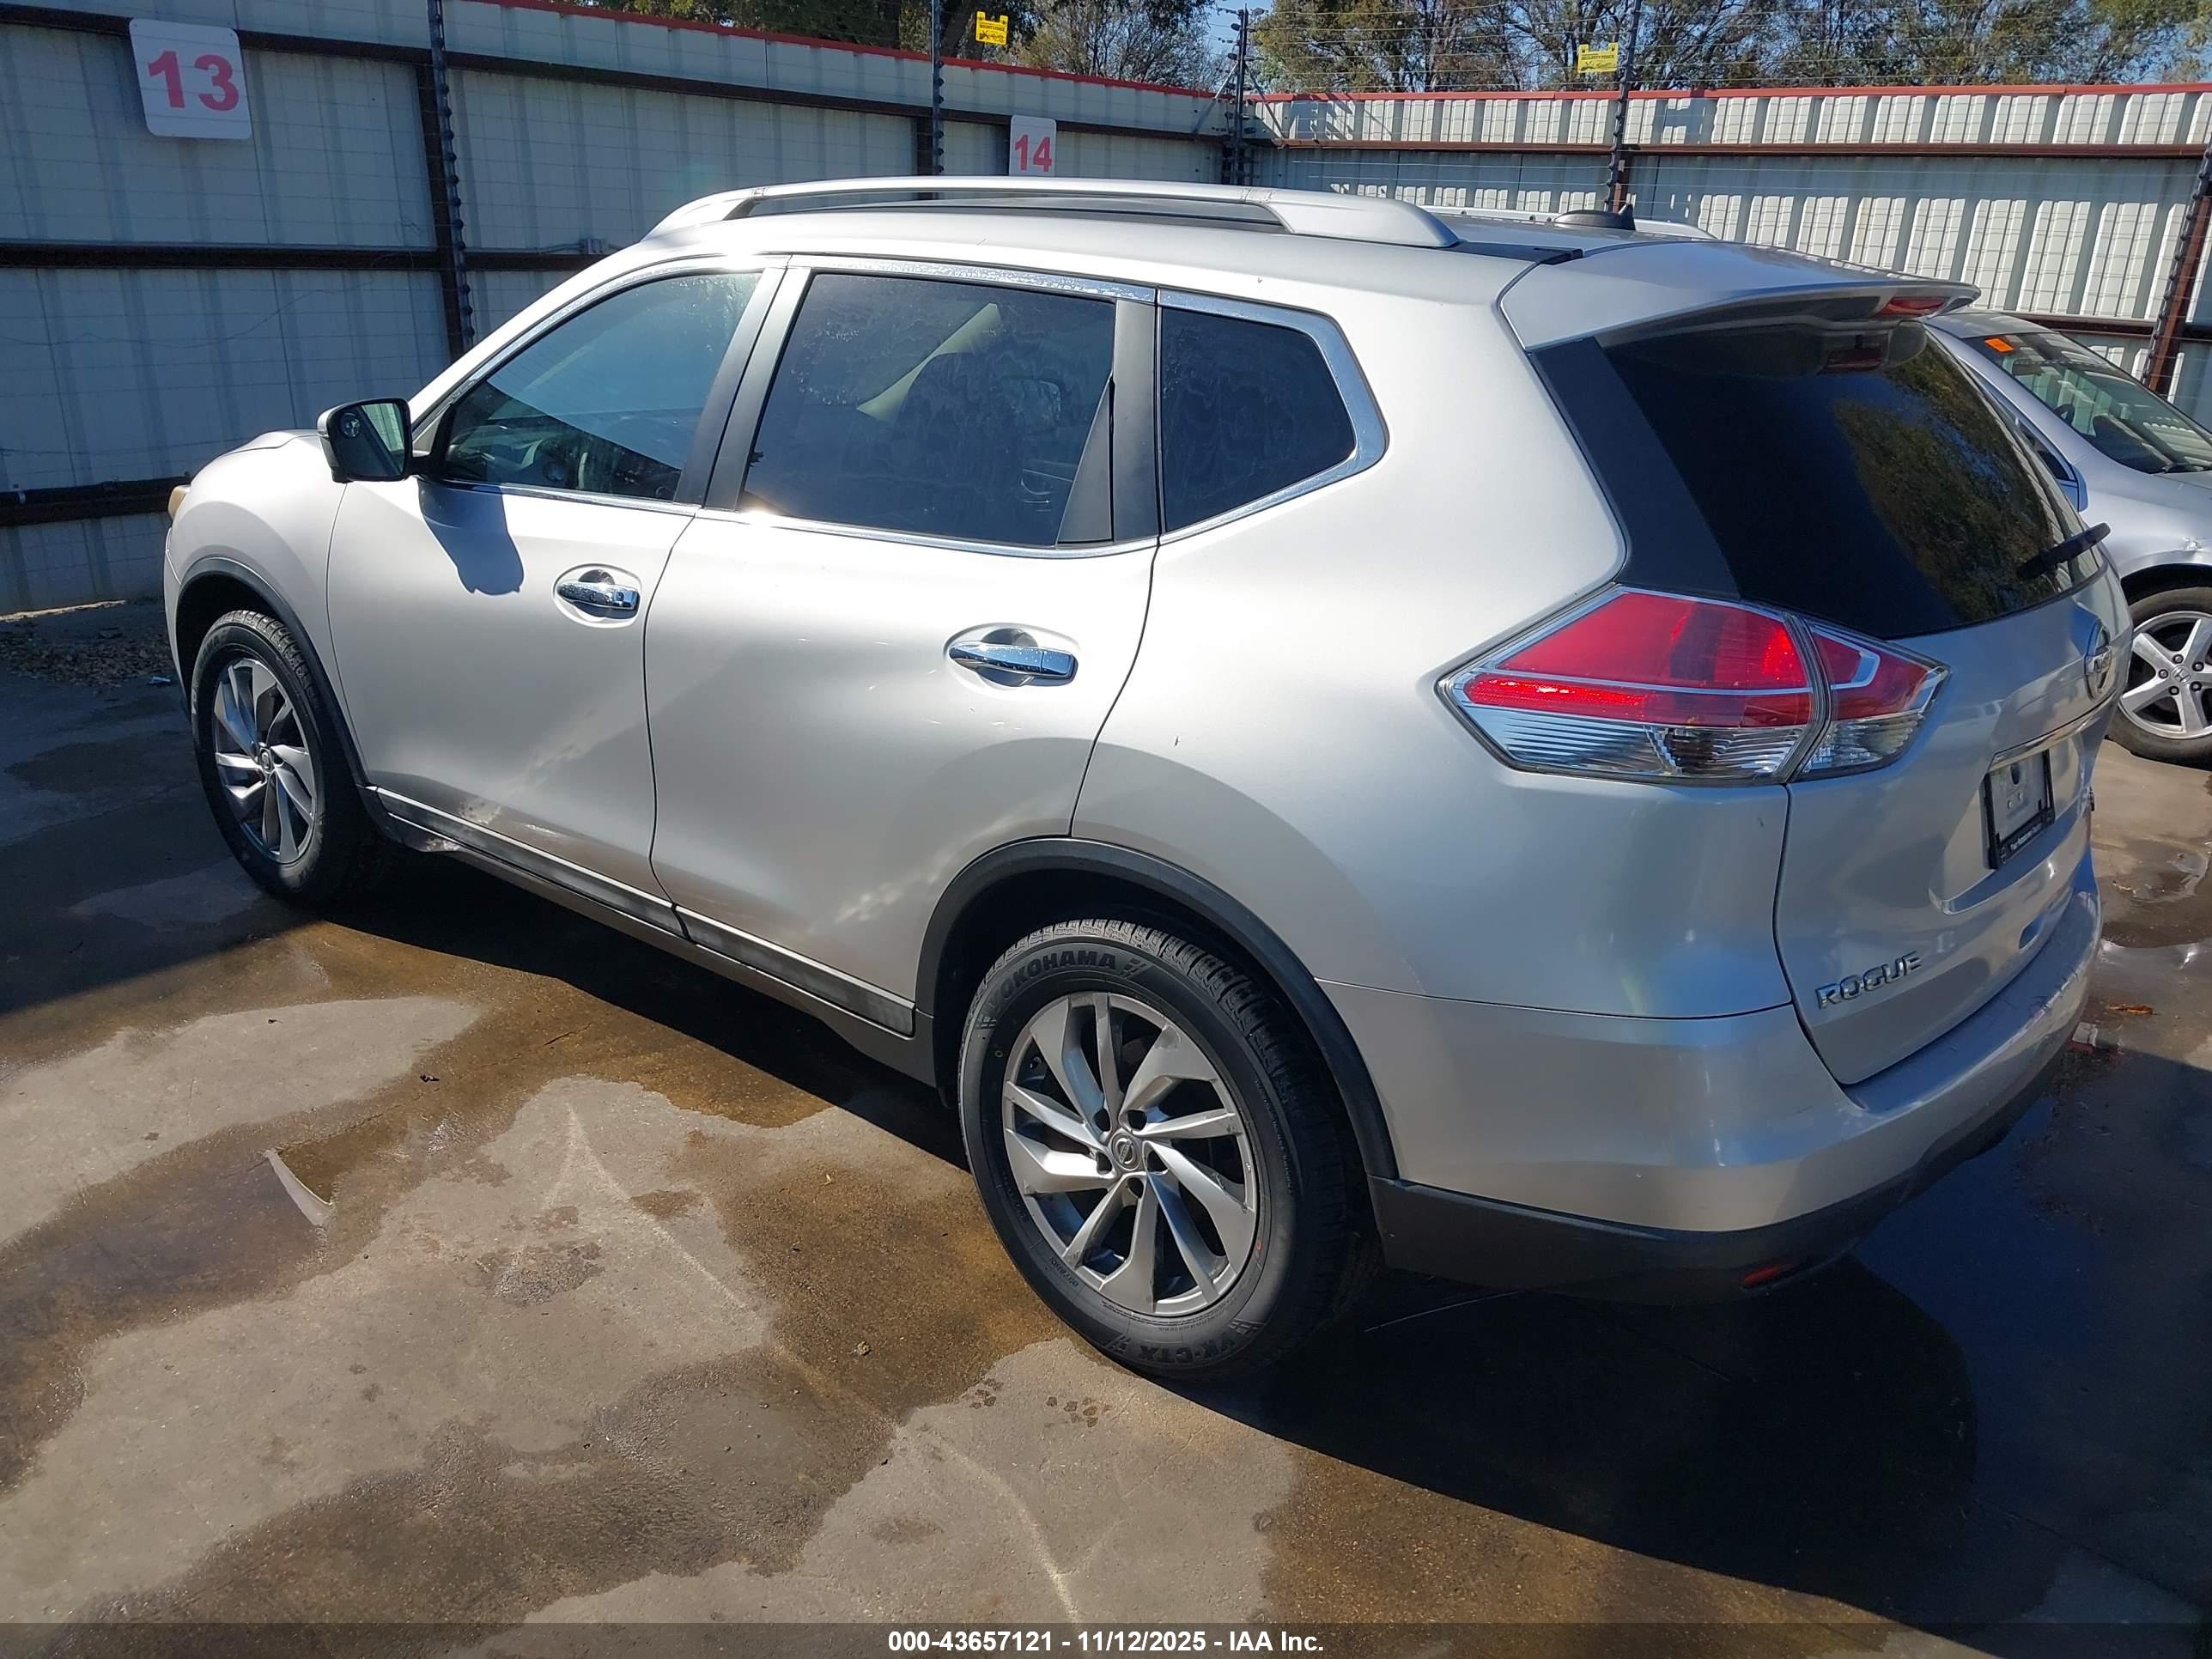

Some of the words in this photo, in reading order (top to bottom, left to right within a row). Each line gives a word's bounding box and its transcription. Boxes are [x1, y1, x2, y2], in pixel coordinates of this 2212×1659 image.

[148, 51, 240, 111] 13
[1014, 134, 1053, 173] 14
[990, 950, 1116, 1012] YOKOHAMA
[1815, 950, 1921, 1010] ROGUE
